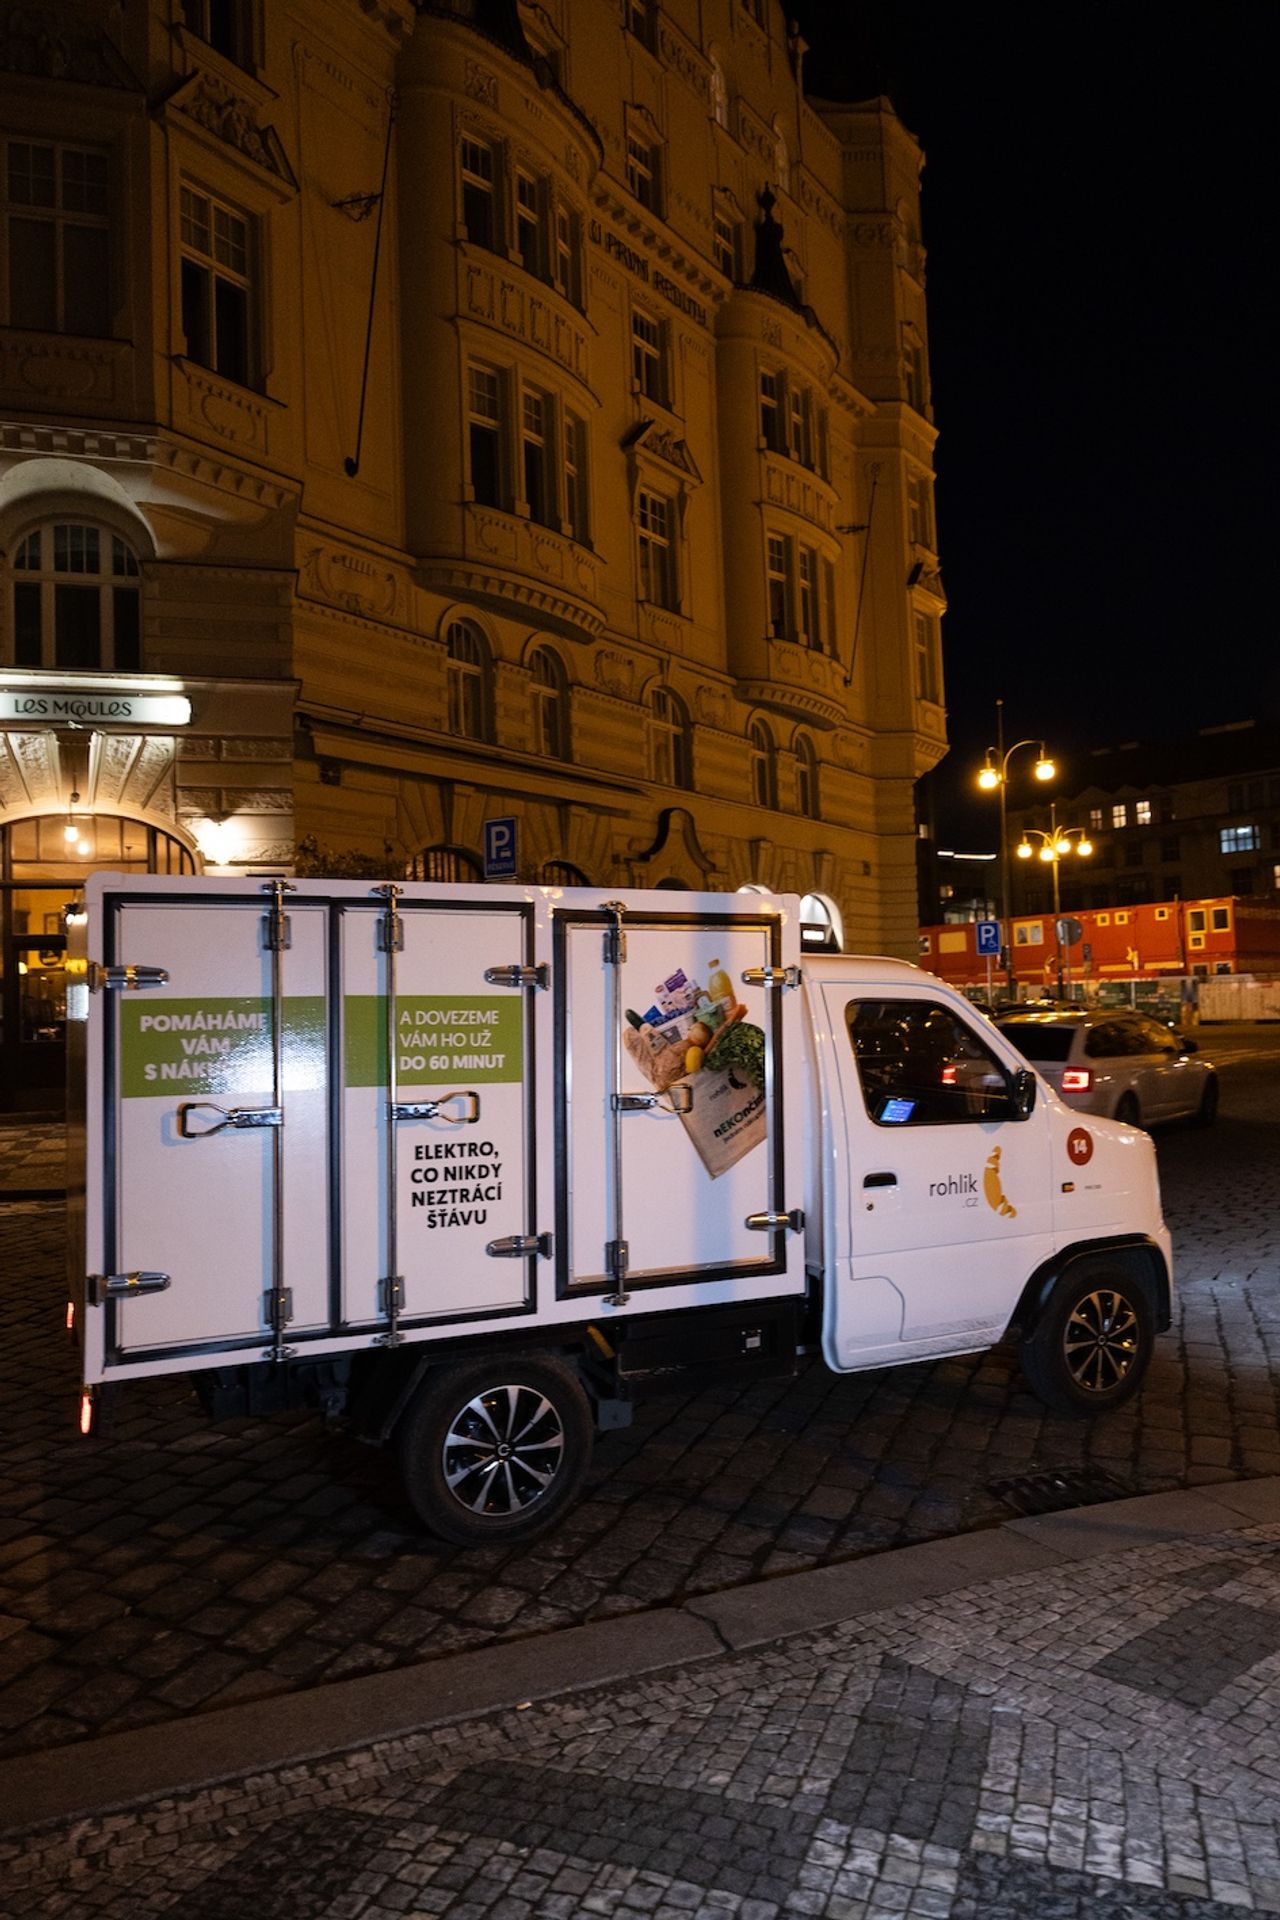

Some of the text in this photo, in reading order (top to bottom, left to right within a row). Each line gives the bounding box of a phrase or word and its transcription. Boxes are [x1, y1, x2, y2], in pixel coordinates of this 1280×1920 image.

[490, 825, 511, 860] P
[980, 925, 996, 946] P
[400, 1010, 500, 1026] A DOVEZEME
[181, 1034, 231, 1055] VÁM
[399, 1029, 492, 1048] VÁM HO UŽ
[143, 1063, 157, 1081] S
[399, 1054, 506, 1071] DO 60 MINUT
[414, 1141, 499, 1161] ELEKTRO,
[1072, 1138, 1088, 1155] 14
[411, 1163, 502, 1184] CO NIKDY
[411, 1182, 502, 1207] NEZTRÁCÍ
[929, 1174, 978, 1197] rohlik
[427, 1207, 487, 1229] ŠŤÁVU
